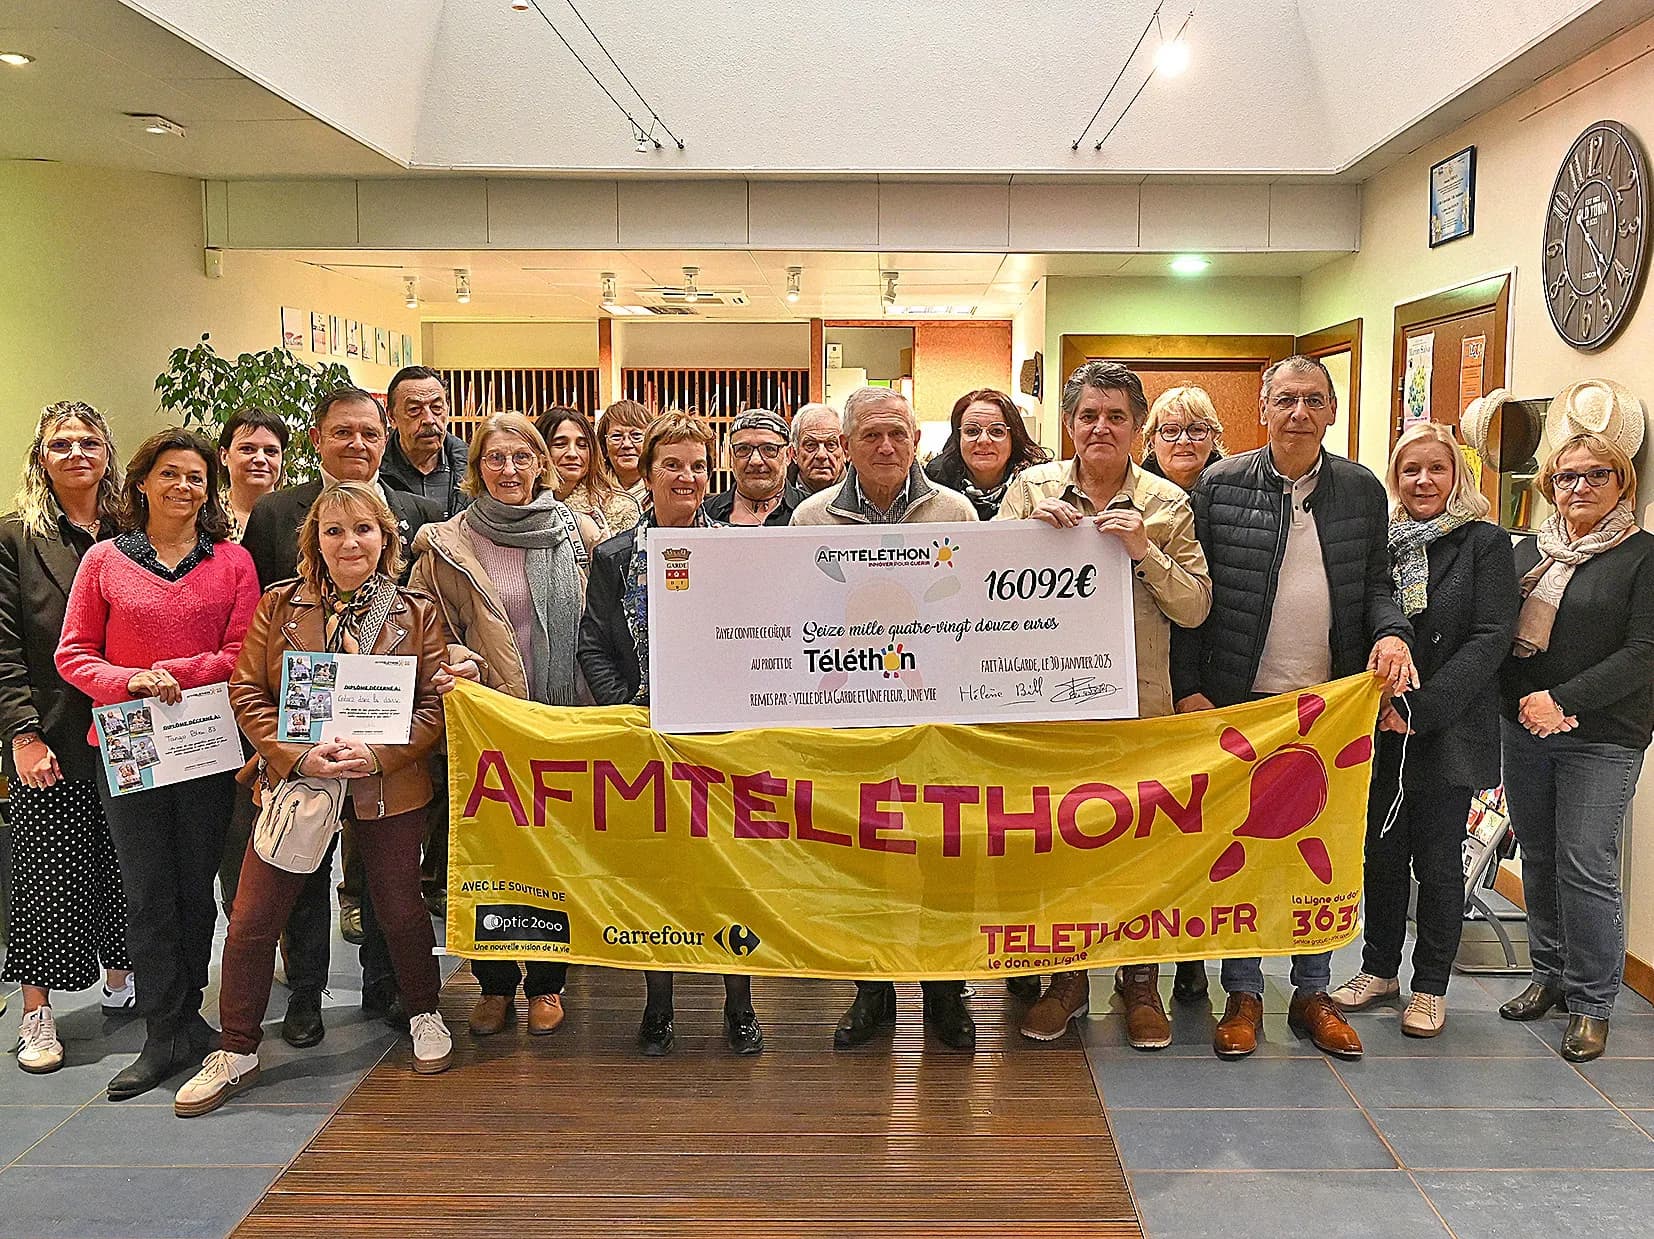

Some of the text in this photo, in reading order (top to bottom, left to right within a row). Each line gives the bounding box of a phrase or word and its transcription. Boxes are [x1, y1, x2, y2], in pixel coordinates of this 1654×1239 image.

[1587, 135, 1602, 179] 12
[1606, 139, 1621, 181] 1
[1568, 152, 1585, 197] 11
[1612, 258, 1633, 288] 4
[1550, 270, 1568, 299] 8
[1562, 290, 1579, 328] 7
[1582, 299, 1592, 339] 6
[984, 564, 1097, 601] 16092€
[715, 624, 791, 641] PAYEZ CONTRE CE CHÈQUE
[802, 616, 1059, 643] Seize mille quatre-vingt douze euros
[751, 658, 792, 670] AU PROFIT DE
[981, 659, 997, 672] FAIT
[1004, 658, 1013, 672] LA
[1014, 657, 1040, 672] GARDE,
[1041, 657, 1049, 670] LE
[1050, 655, 1059, 670] 30
[1060, 656, 1093, 671] JANVIER
[1094, 653, 1111, 669] 2025
[750, 692, 773, 706] REMIS
[774, 692, 788, 705] PAR
[793, 691, 813, 704] VILLE
[814, 691, 823, 704] DE
[824, 689, 832, 704] LA
[833, 689, 856, 705] GARDE
[857, 690, 865, 703] ET
[866, 688, 882, 703] UNE
[907, 688, 922, 701] UNE
[923, 687, 936, 700] VIE
[461, 880, 566, 902] AVEC LE SOUTIEN DE
[1292, 890, 1359, 906] la Ligne du do
[490, 915, 563, 932] Optic 2000
[602, 925, 705, 945] Carrefour
[490, 943, 519, 951] nouvelle
[542, 943, 551, 951] de
[552, 943, 558, 951] la
[560, 944, 569, 953] vie
[988, 957, 1001, 969] le
[1004, 957, 1030, 968] don
[1033, 957, 1050, 967] en
